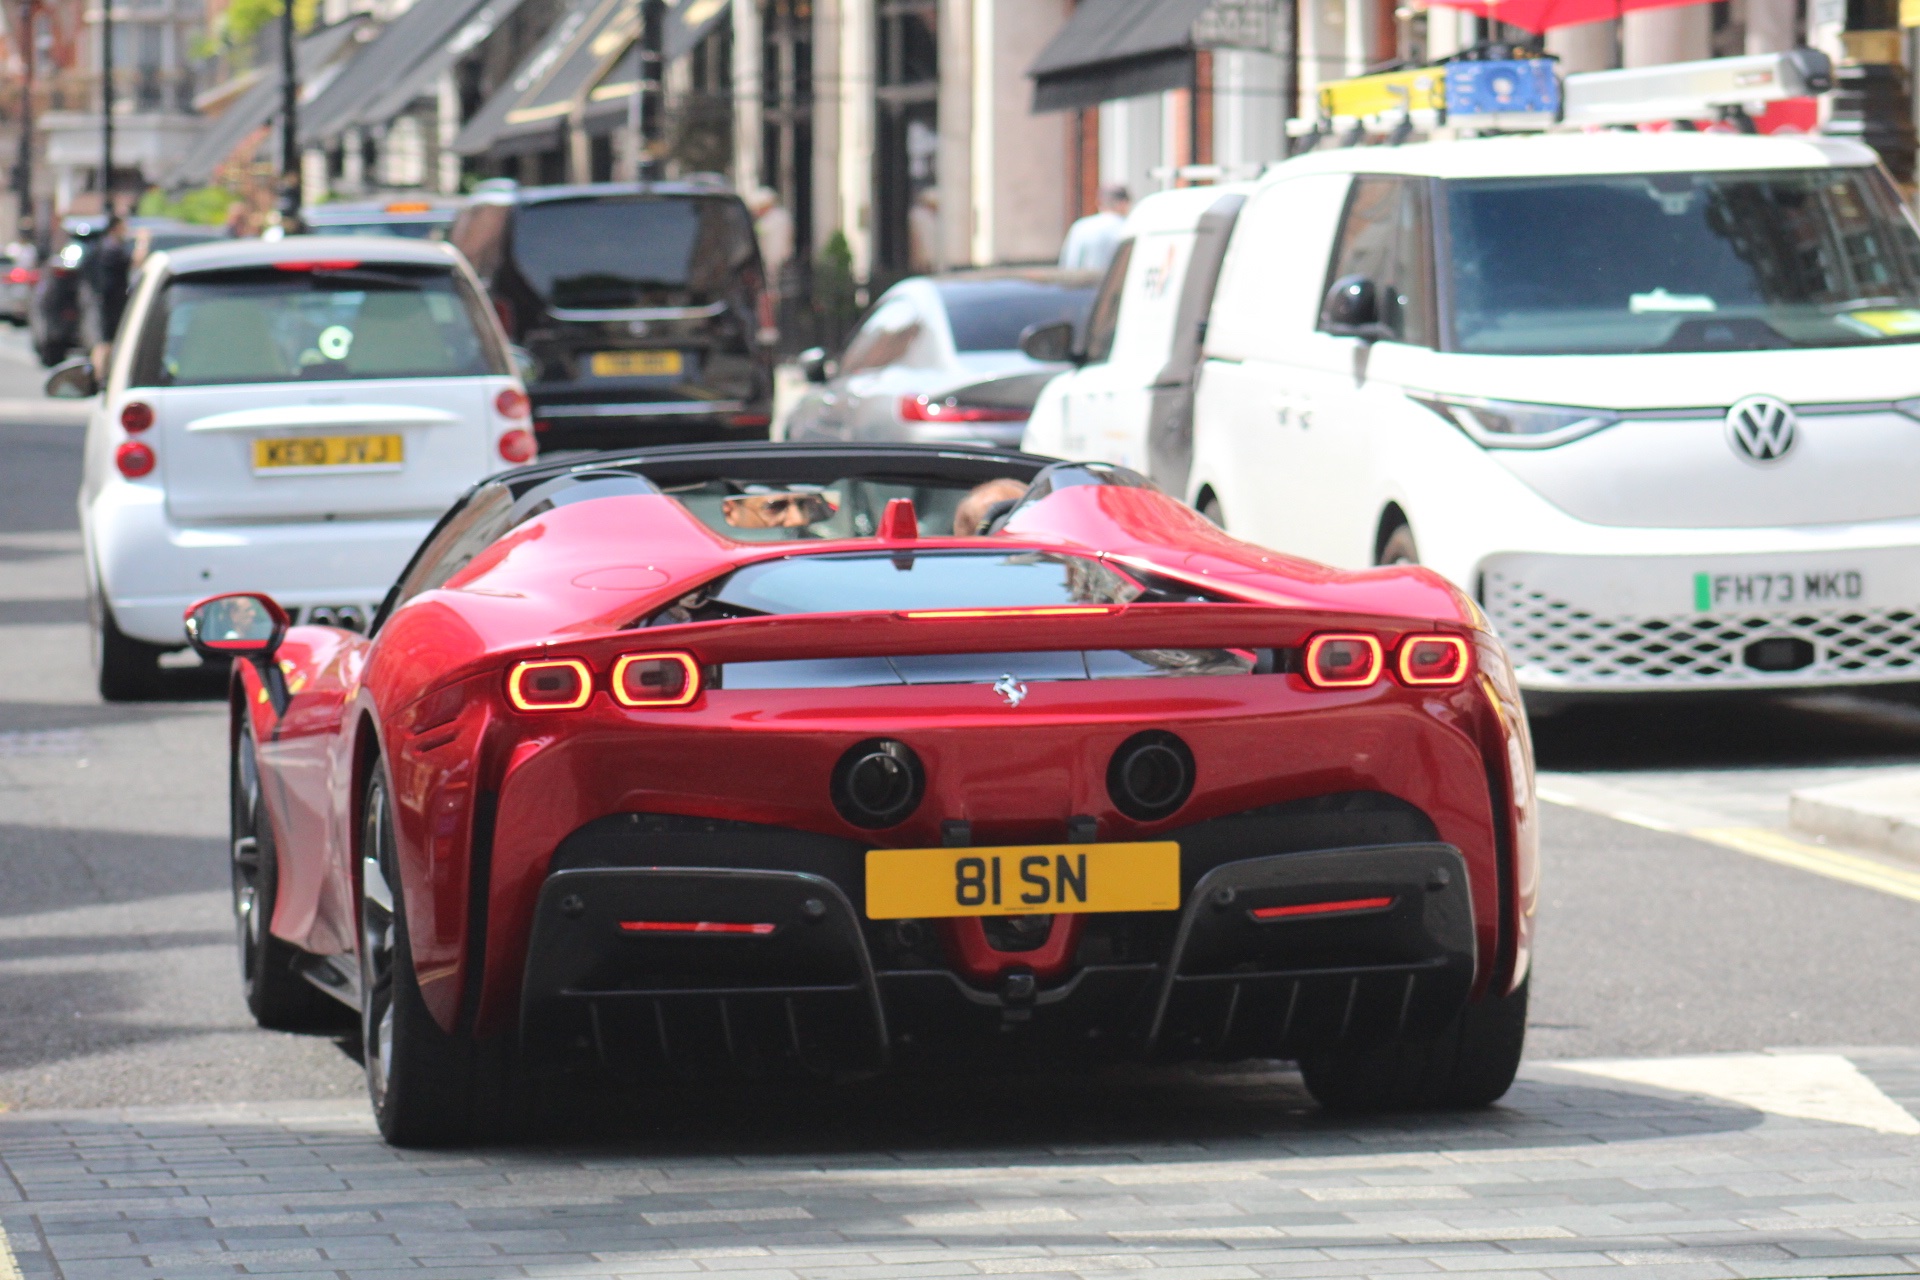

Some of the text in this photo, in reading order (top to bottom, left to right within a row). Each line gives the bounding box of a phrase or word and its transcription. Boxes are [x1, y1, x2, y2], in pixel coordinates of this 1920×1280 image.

[338, 436, 389, 463] JVJ
[1713, 570, 1862, 602] FH73 MKD
[955, 853, 1087, 906] 81 SN
